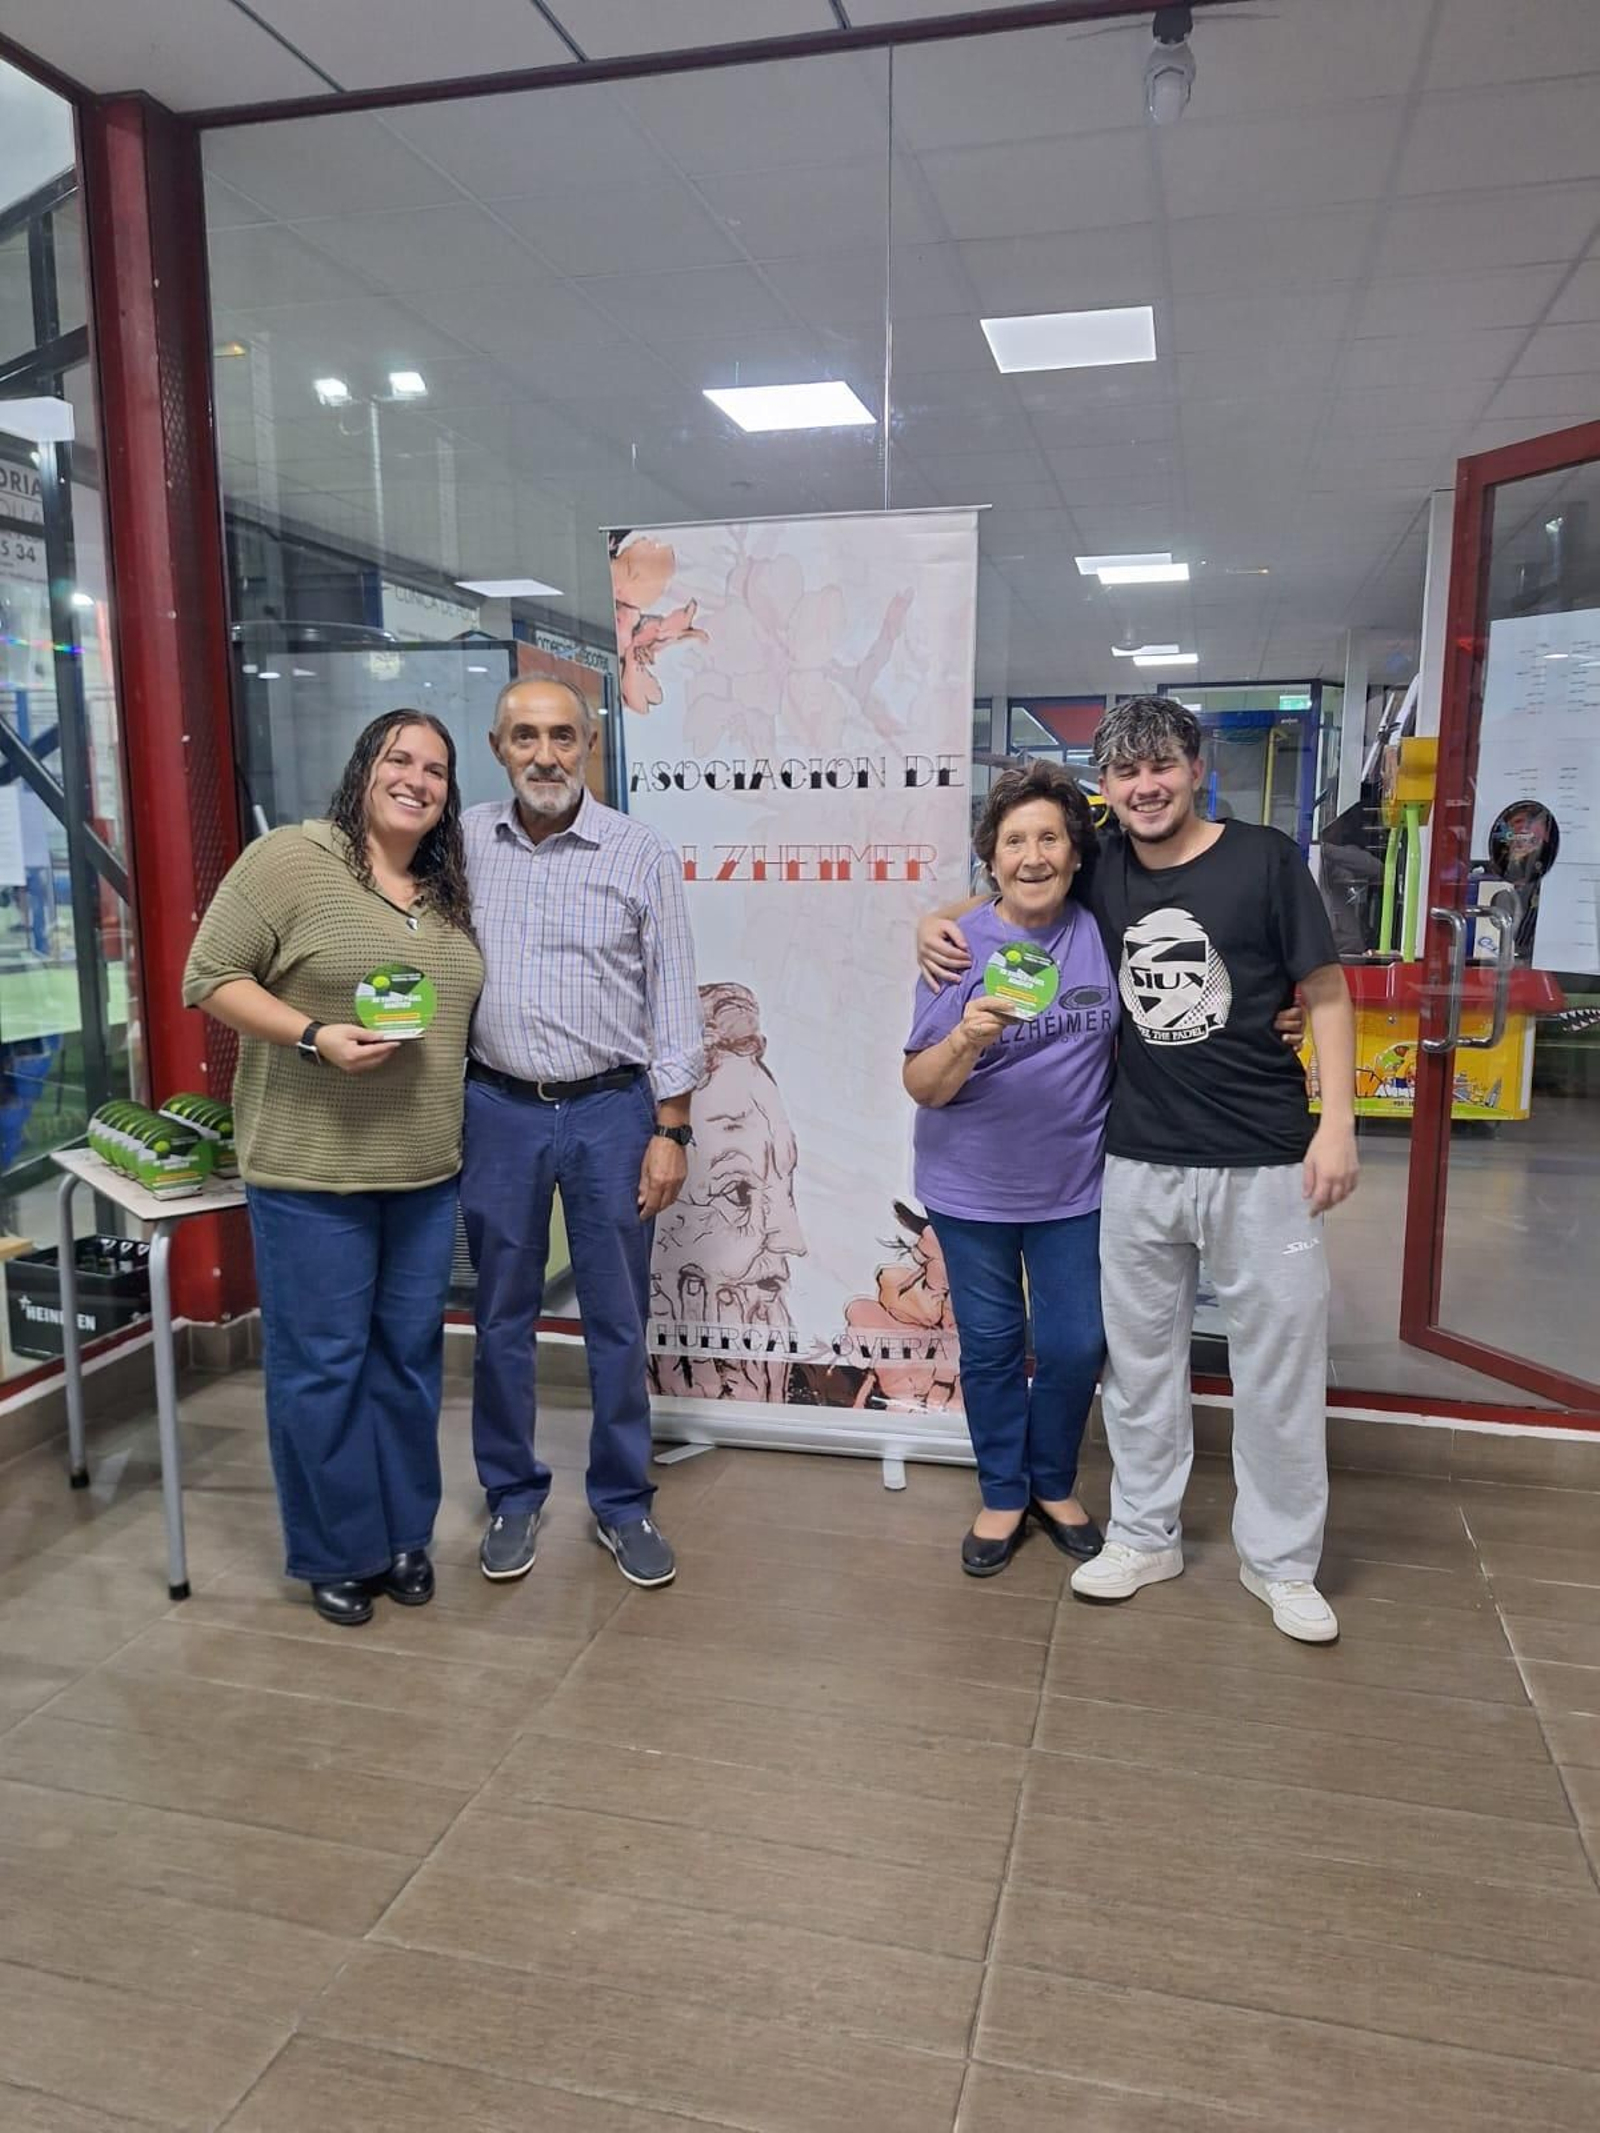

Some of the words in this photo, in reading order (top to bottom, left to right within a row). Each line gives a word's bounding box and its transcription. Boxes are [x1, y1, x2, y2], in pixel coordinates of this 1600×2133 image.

[630, 756, 885, 792] ASOCIACION
[903, 754, 964, 789] DE
[681, 844, 938, 881] LZHEIMER
[1130, 966, 1206, 990] SIUX
[990, 1009, 1112, 1049] LZHEIMER
[26, 1305, 95, 1331] HEINEN
[831, 1332, 949, 1361] OVERA
